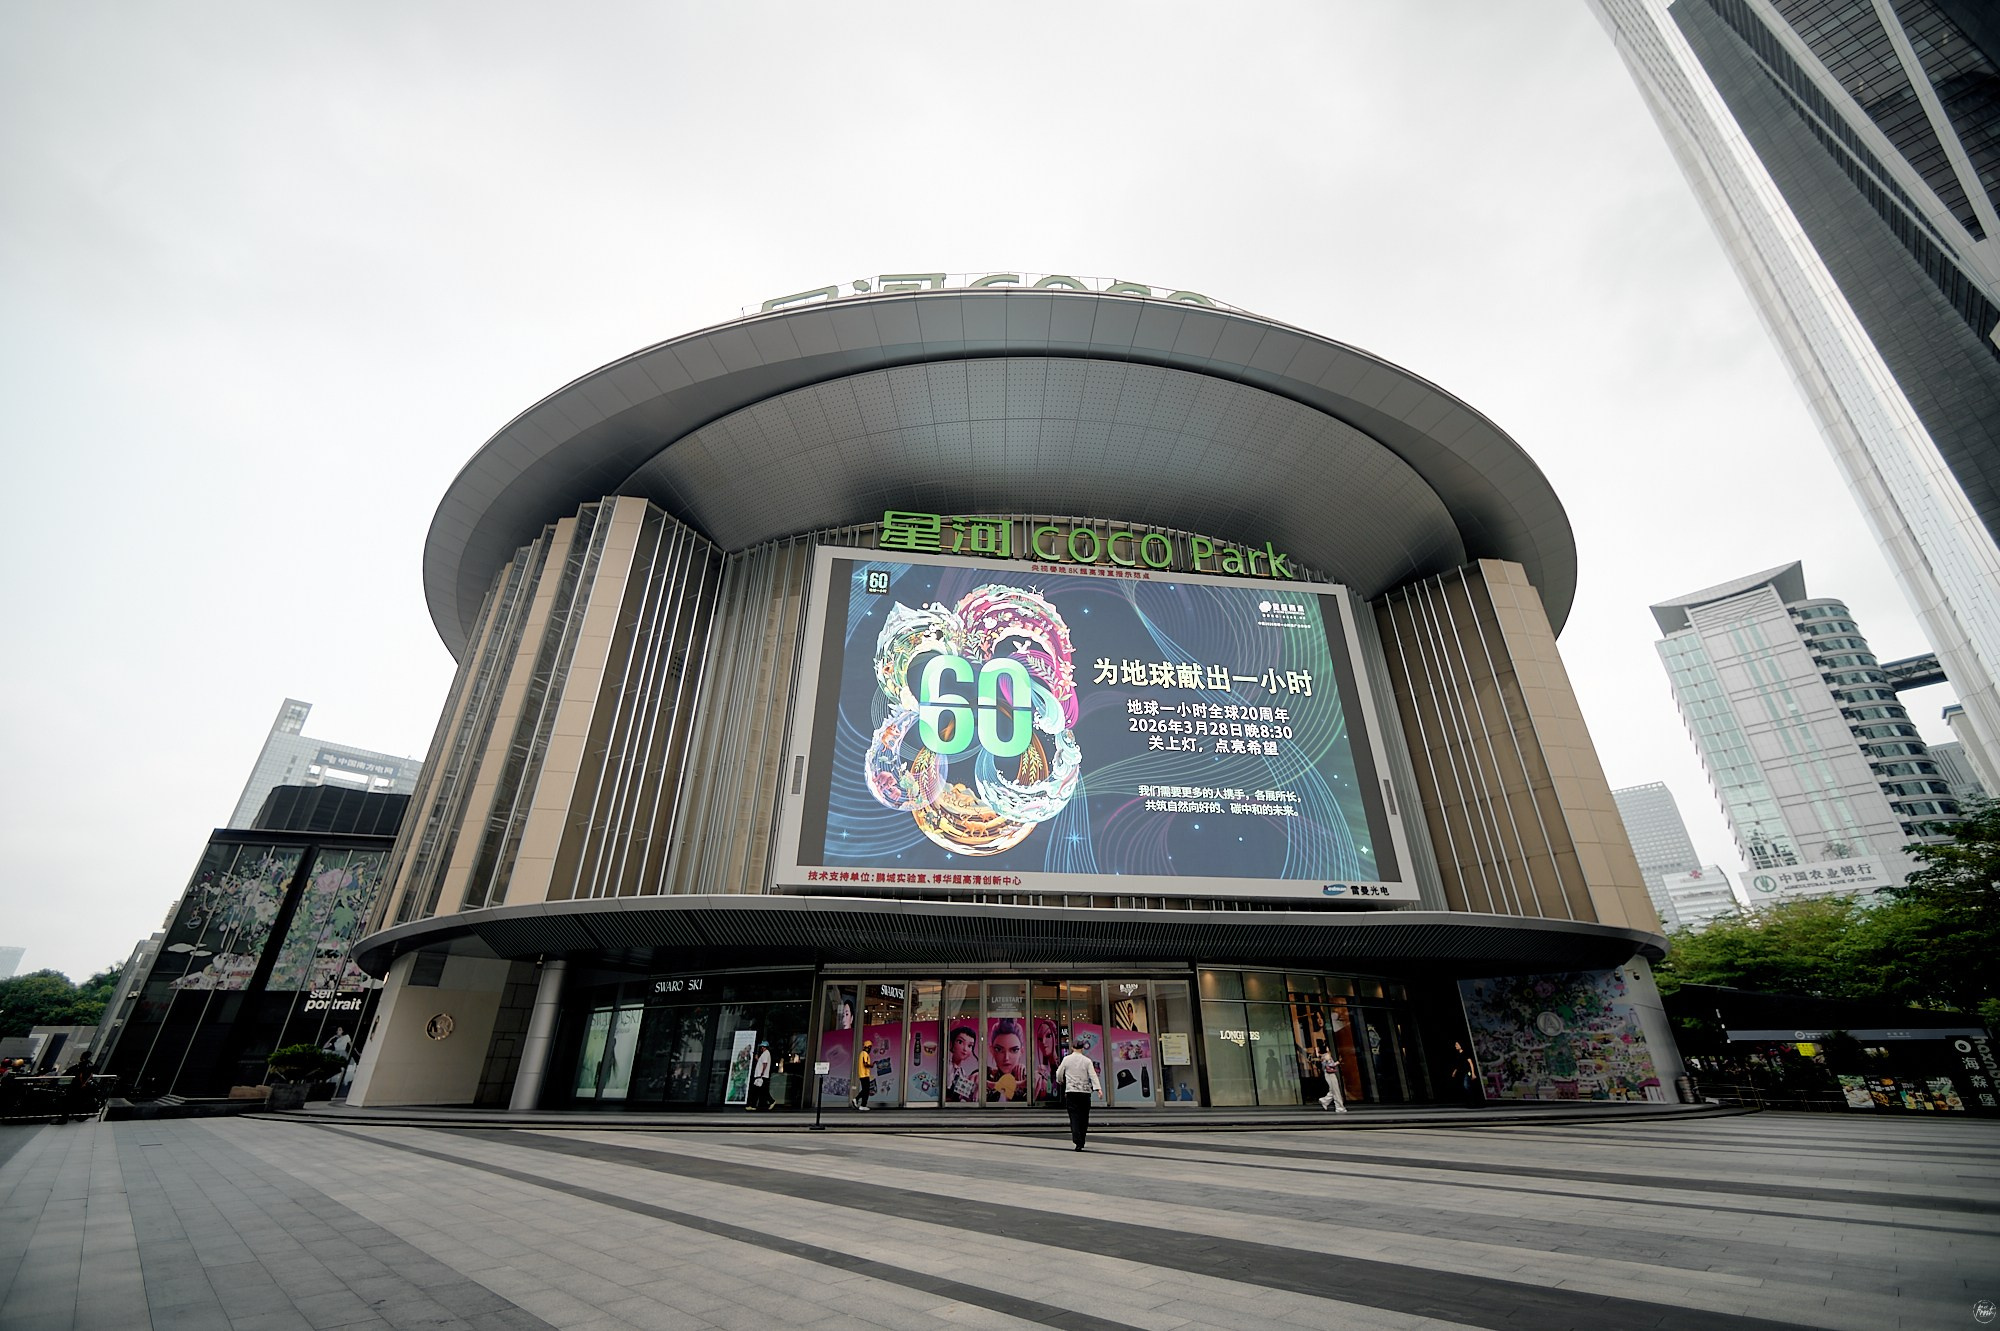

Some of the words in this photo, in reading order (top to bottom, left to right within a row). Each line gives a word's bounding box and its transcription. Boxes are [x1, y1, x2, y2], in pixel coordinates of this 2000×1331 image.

[879, 510, 1012, 557] 星河
[1032, 526, 1172, 568] COCO
[1190, 537, 1293, 578] Park
[869, 572, 888, 588] 60
[1093, 657, 1313, 697] 为地球献出一小时
[919, 654, 1033, 758] 60
[1127, 699, 1290, 723] 地球一小时全球20周年
[1129, 718, 1293, 740] 2026年3月28日晚8:30
[1779, 863, 1871, 884] 中国农业银行
[1350, 885, 1390, 896] 雷曼光电
[655, 979, 702, 992] SWAROSKI
[304, 998, 362, 1013] portrait
[1220, 1030, 1260, 1040] LONGIES
